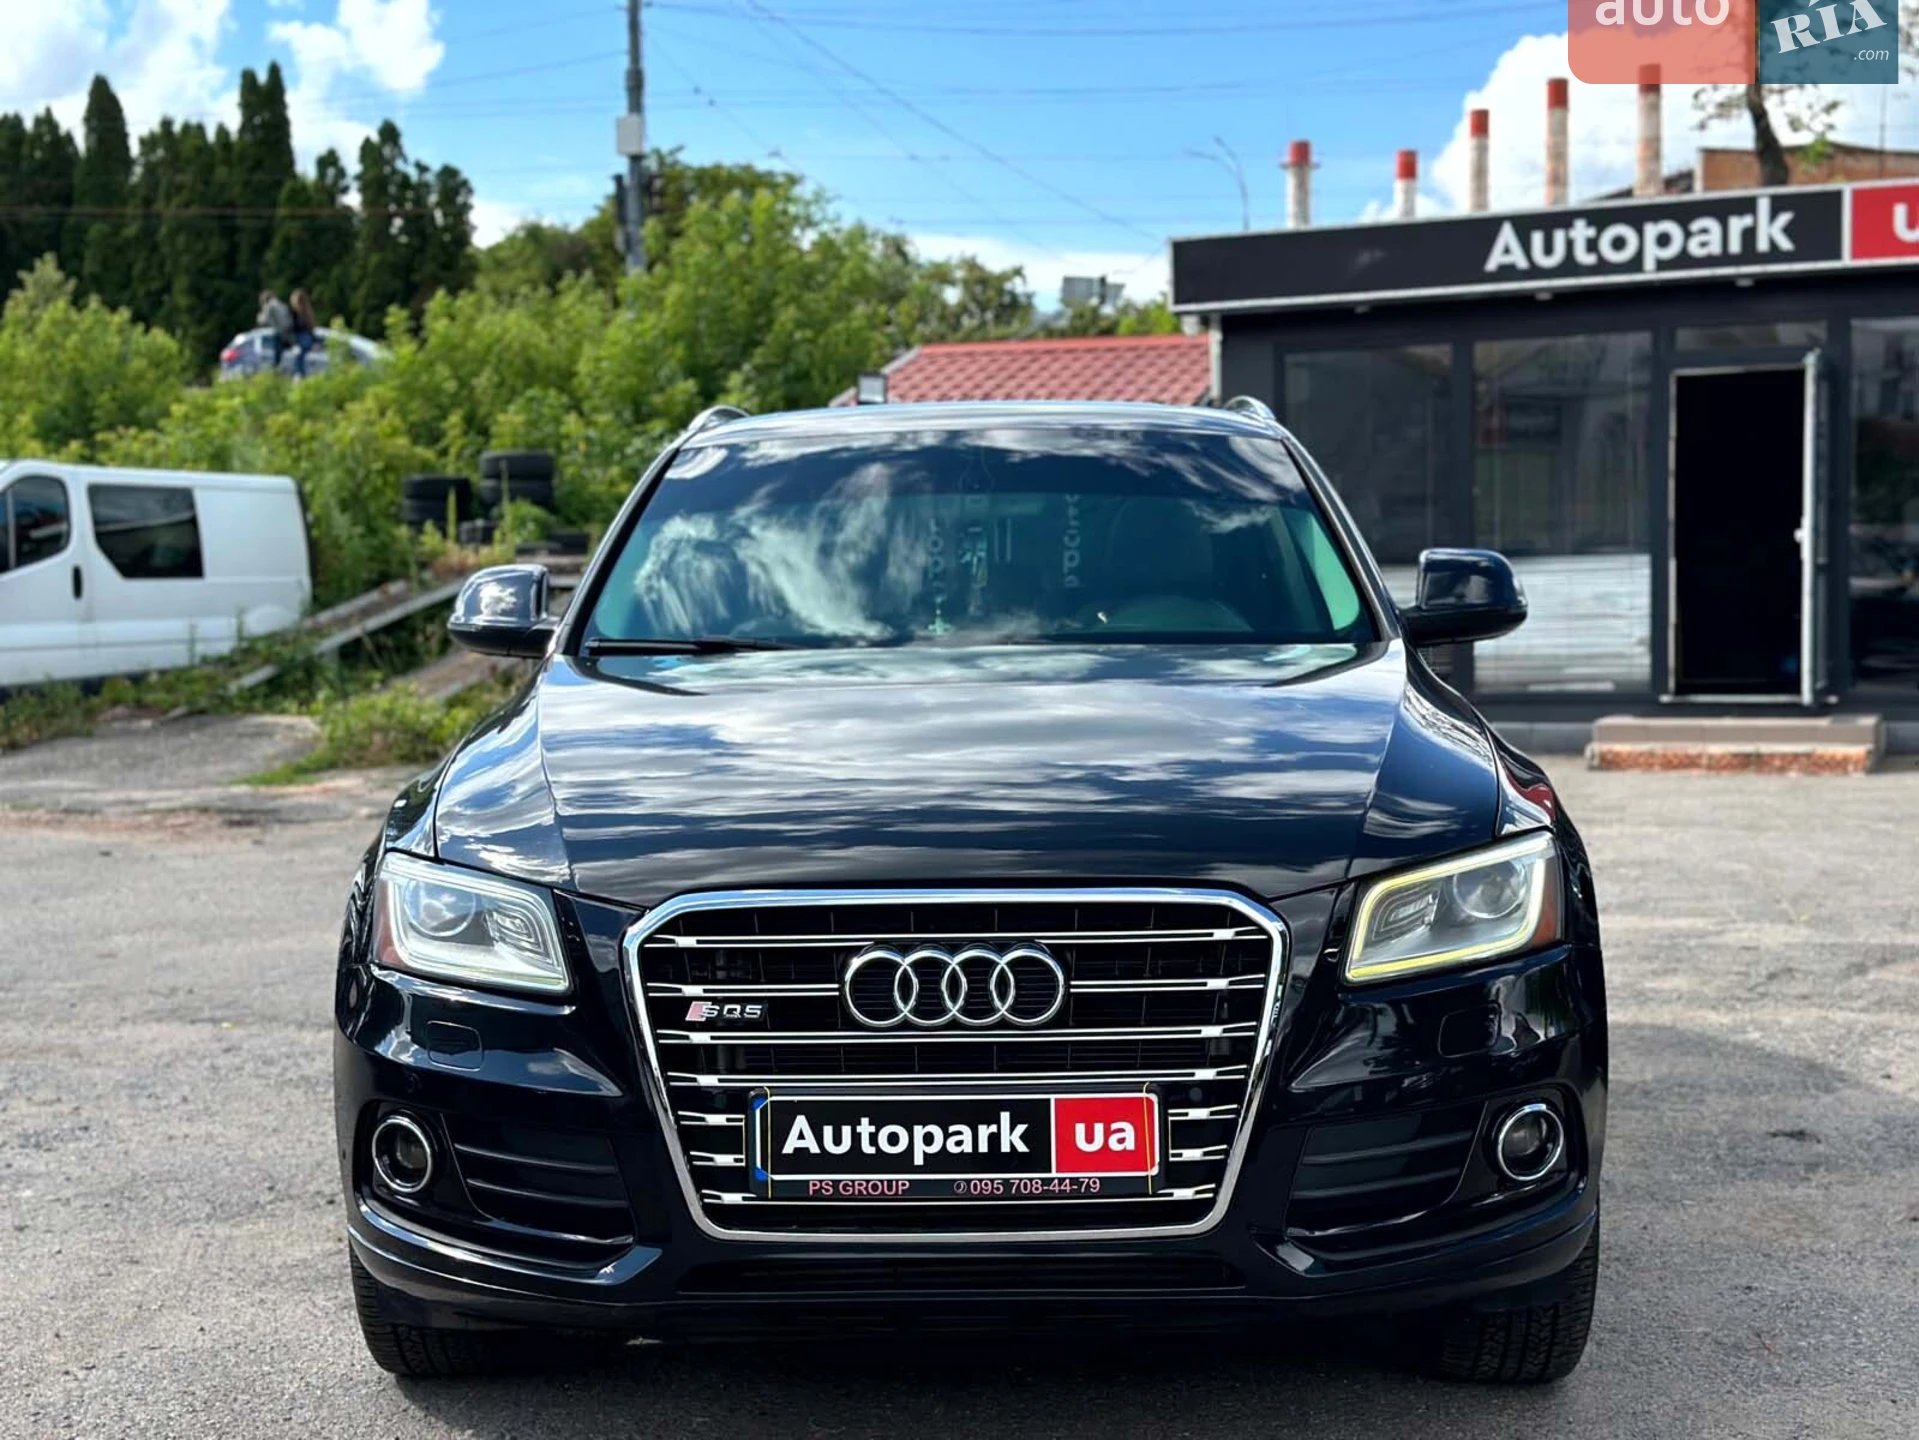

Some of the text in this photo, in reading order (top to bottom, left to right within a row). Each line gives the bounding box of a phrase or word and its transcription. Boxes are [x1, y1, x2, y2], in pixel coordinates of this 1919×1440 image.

[1483, 195, 1796, 273] Autopark
[781, 1112, 1136, 1166] Autopark ua
[808, 1178, 1101, 1196] PS GROUP 095 708-44-79
